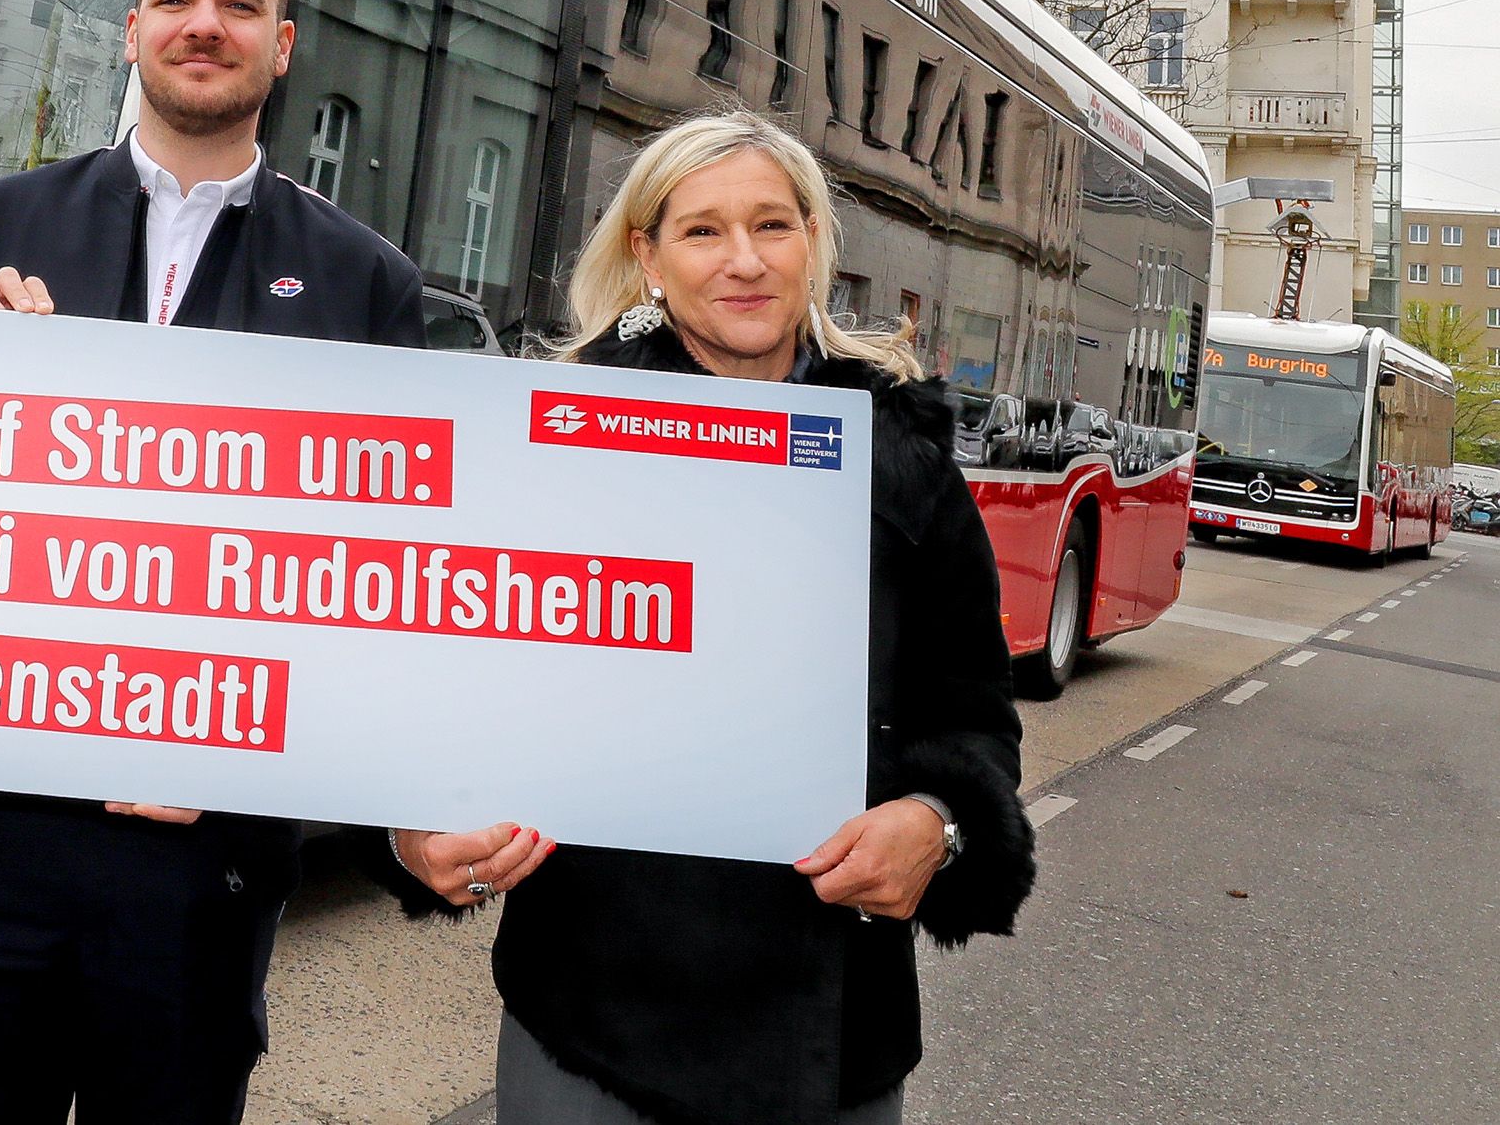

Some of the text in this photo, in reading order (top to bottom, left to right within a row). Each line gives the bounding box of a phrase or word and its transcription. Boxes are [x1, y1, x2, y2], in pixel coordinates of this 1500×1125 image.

[164, 263, 178, 297] WIENER
[1203, 348, 1328, 378] 7A Burgring
[596, 413, 777, 448] WIENER LINIEN
[793, 439, 821, 448] WIENER
[48, 401, 265, 493] Strom
[300, 433, 433, 502] um:
[793, 447, 838, 458] STADTWERKE
[793, 456, 821, 465] GRUPPE
[46, 536, 174, 607] von
[205, 532, 673, 645] Rudolfsheim
